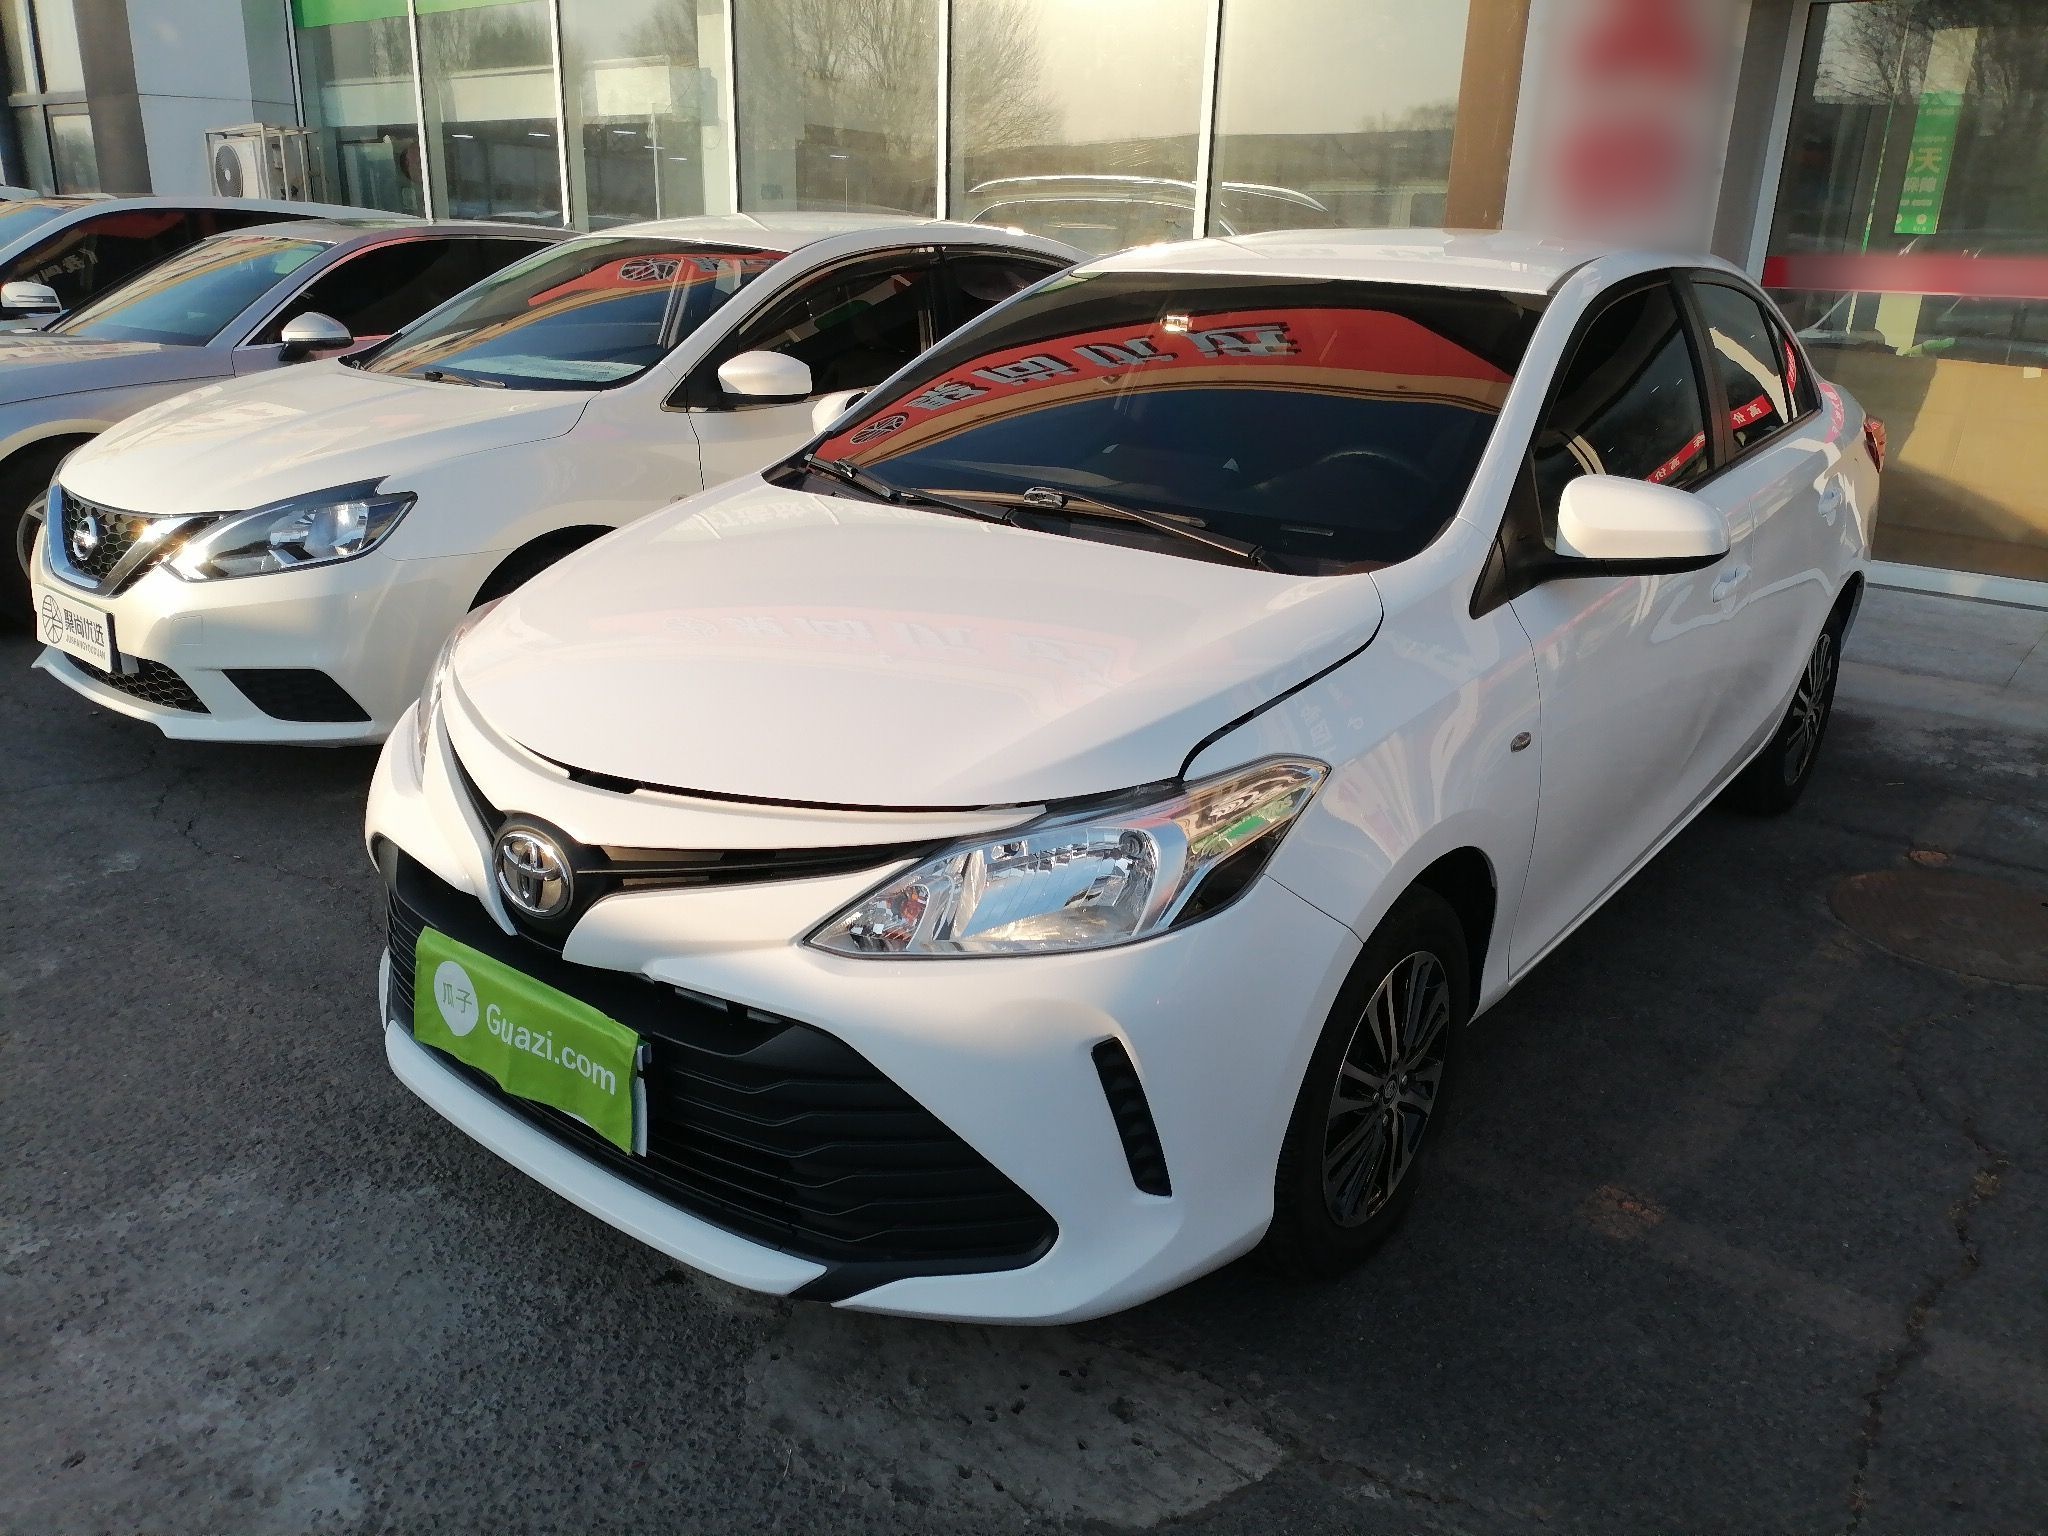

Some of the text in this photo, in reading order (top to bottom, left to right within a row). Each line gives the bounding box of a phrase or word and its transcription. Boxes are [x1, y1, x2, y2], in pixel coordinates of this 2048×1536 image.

[64, 609, 105, 647] 聚尚优选
[442, 980, 473, 1014] 瓜子
[486, 1003, 617, 1096] Guazi.com
